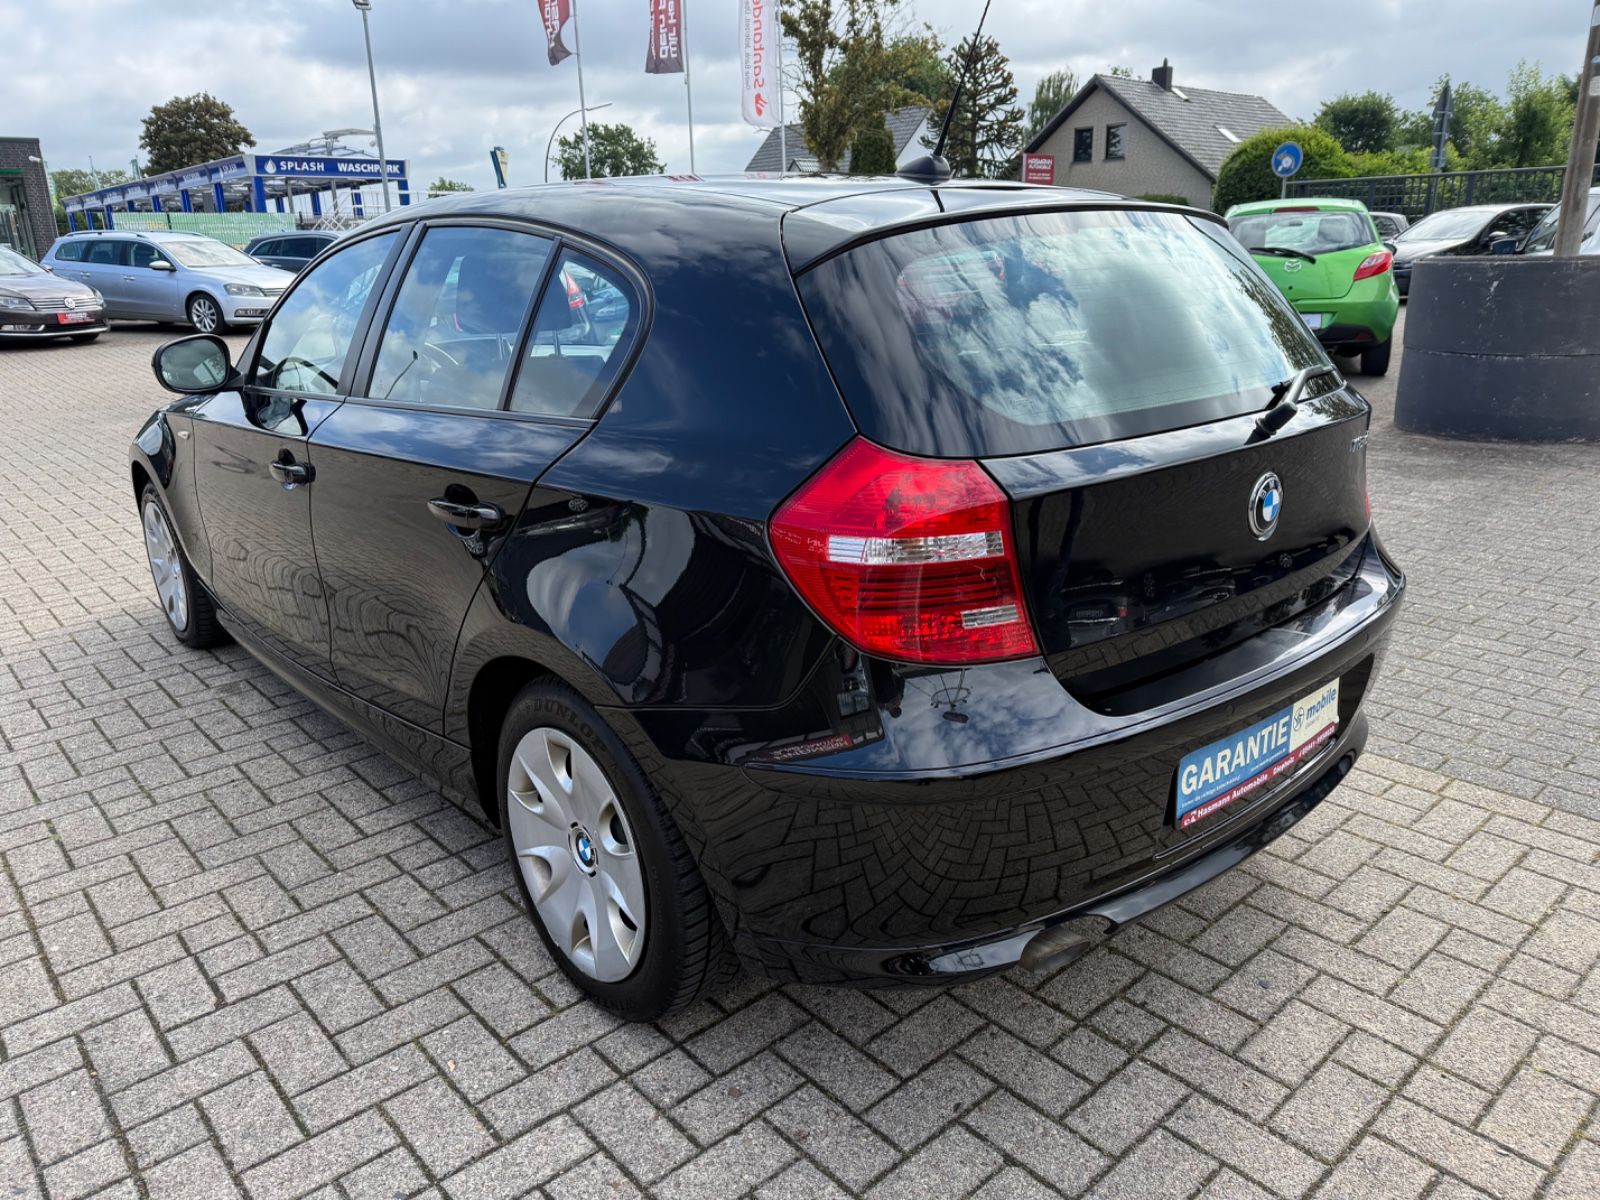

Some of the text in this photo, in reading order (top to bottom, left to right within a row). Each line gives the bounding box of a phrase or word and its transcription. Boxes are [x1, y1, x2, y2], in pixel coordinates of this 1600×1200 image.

[279, 161, 400, 174] SPLASH WASCHPRK
[1305, 686, 1337, 719] mobile
[533, 698, 608, 752] DUNLOP
[1181, 715, 1291, 796] GARANTIE
[1197, 796, 1231, 817] Hasmann
[1231, 773, 1269, 799] Automobile
